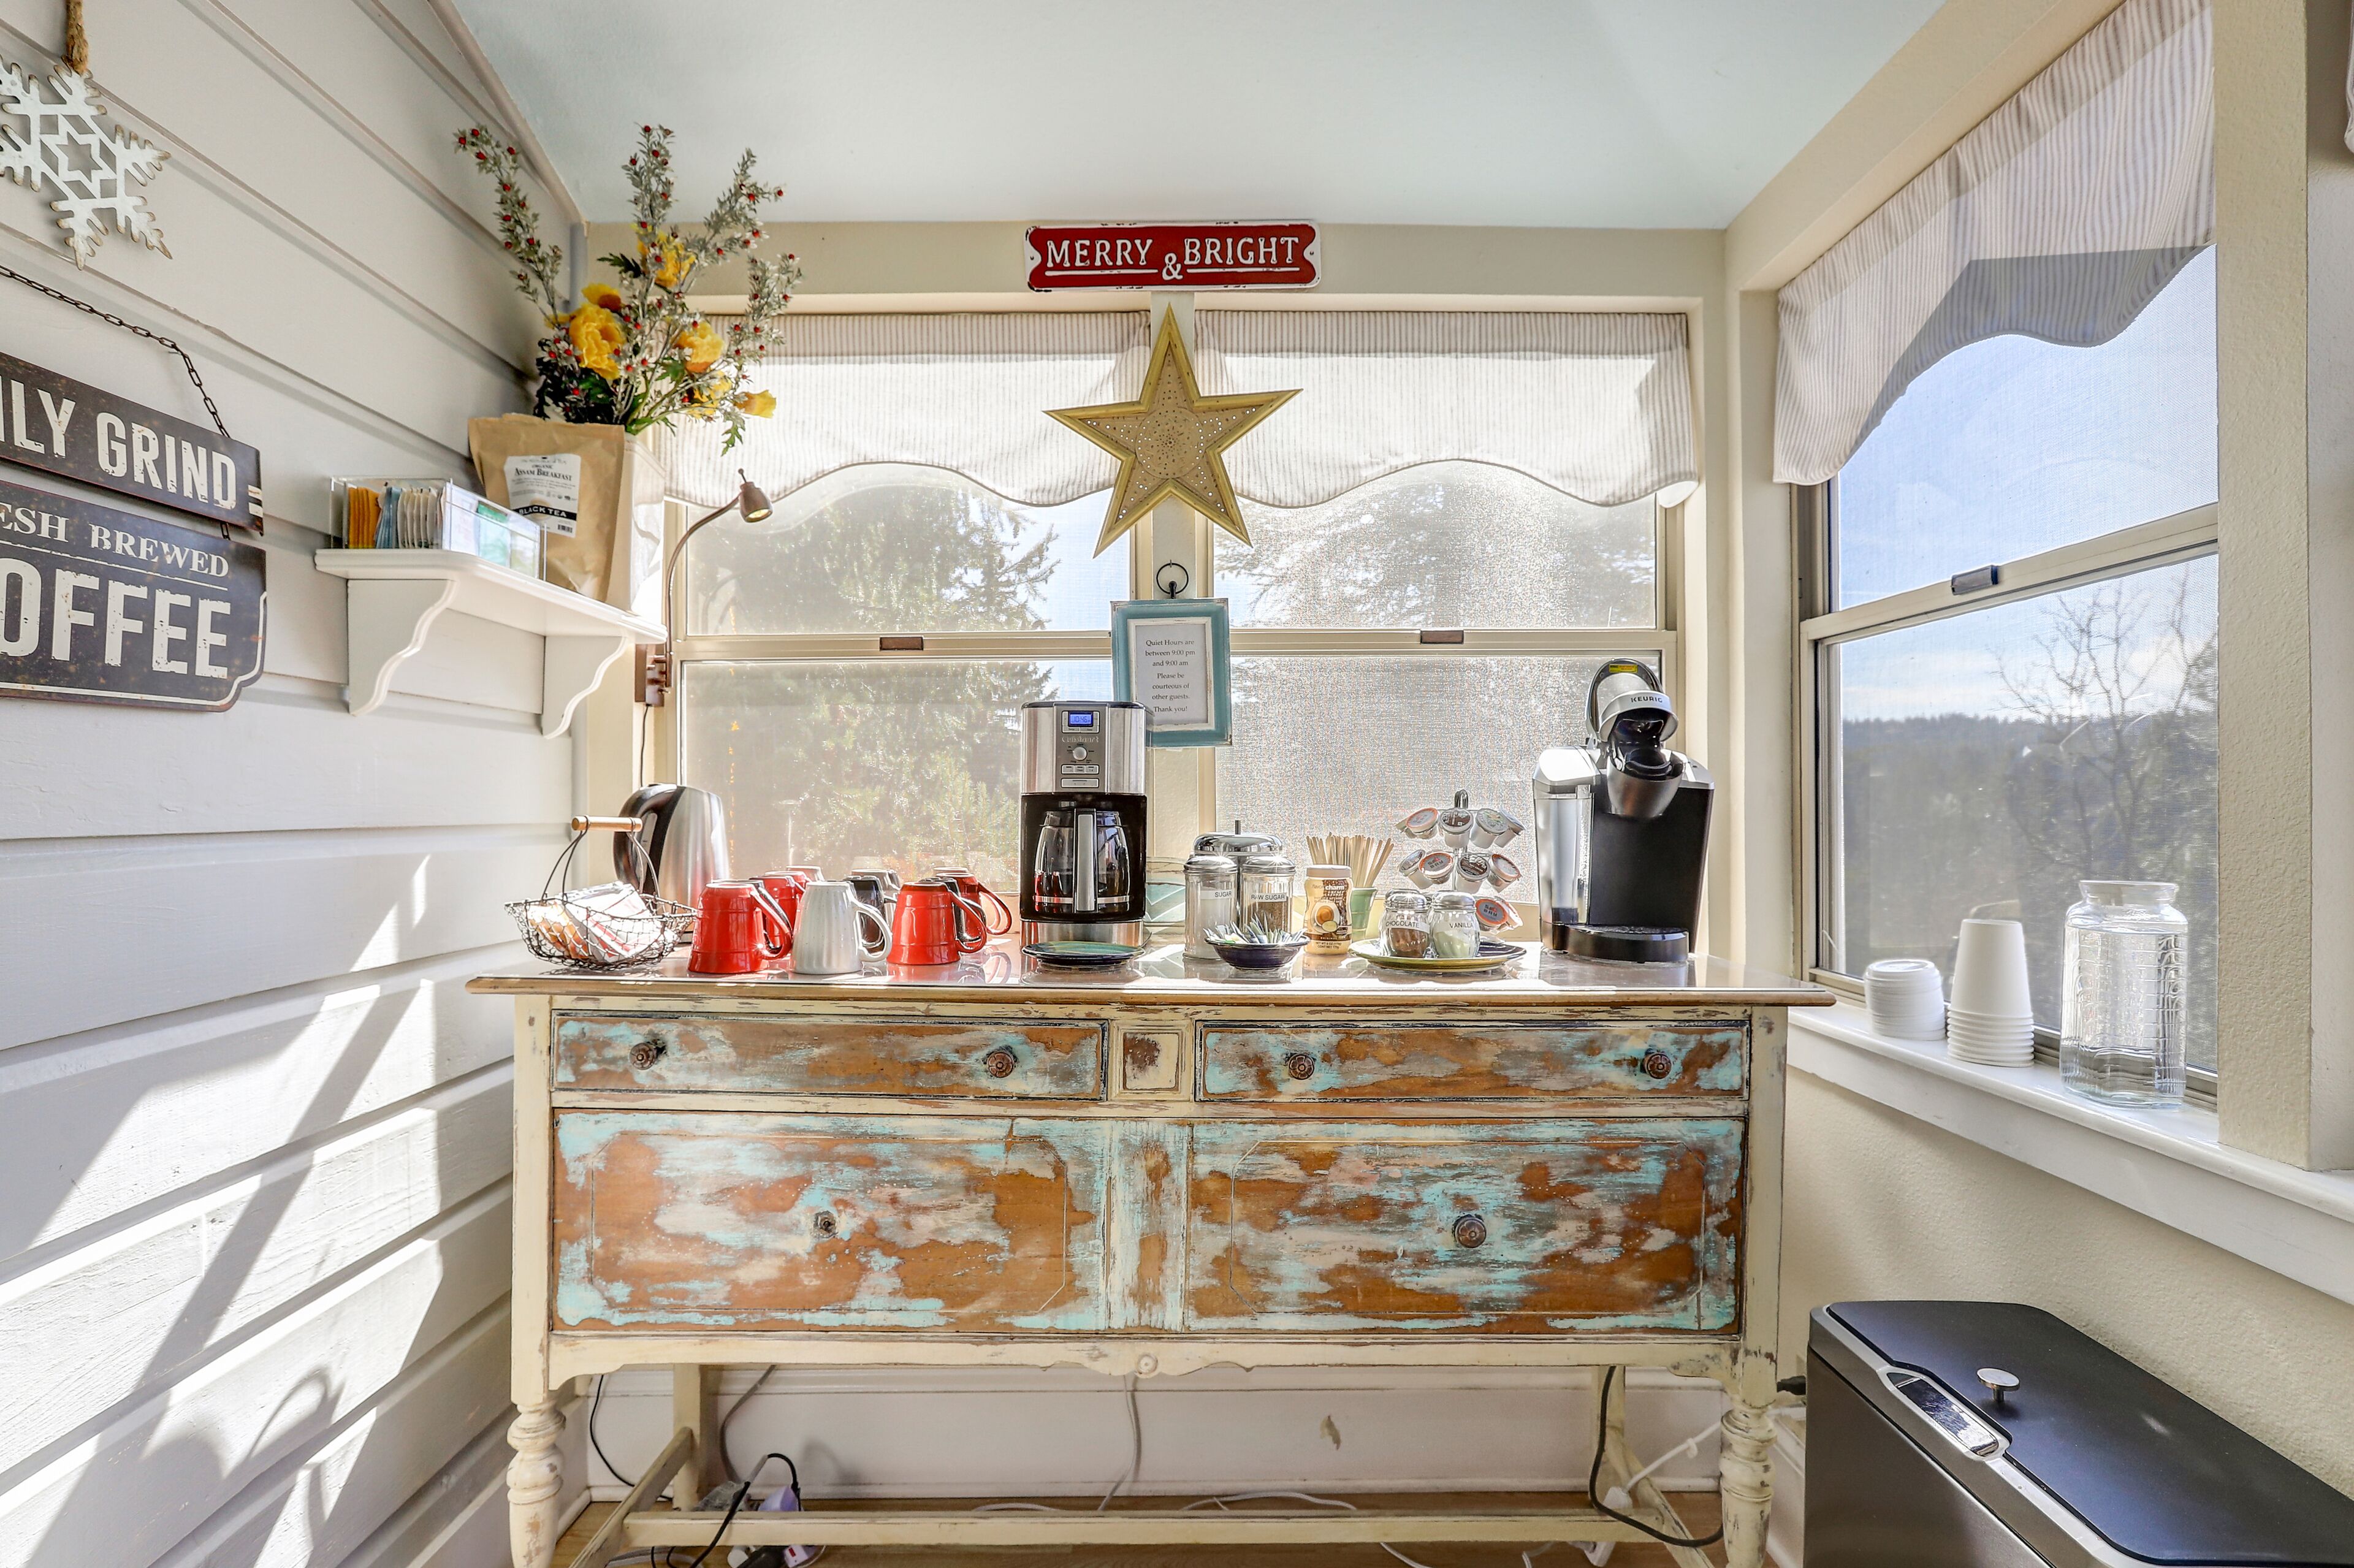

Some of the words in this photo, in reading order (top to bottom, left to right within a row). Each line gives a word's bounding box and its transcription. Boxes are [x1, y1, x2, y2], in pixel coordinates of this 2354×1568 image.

[1046, 239, 1152, 267] MERRY
[1161, 252, 1184, 281] &
[1184, 236, 1299, 265] BRIGHT
[96, 411, 237, 511] GRIND
[515, 467, 535, 476] ASSAM
[536, 468, 573, 481] BREAKFAST
[519, 506, 546, 515] BLACK
[547, 508, 567, 517] TEA
[90, 523, 229, 578] BREWED
[0, 557, 231, 679] OFFEE
